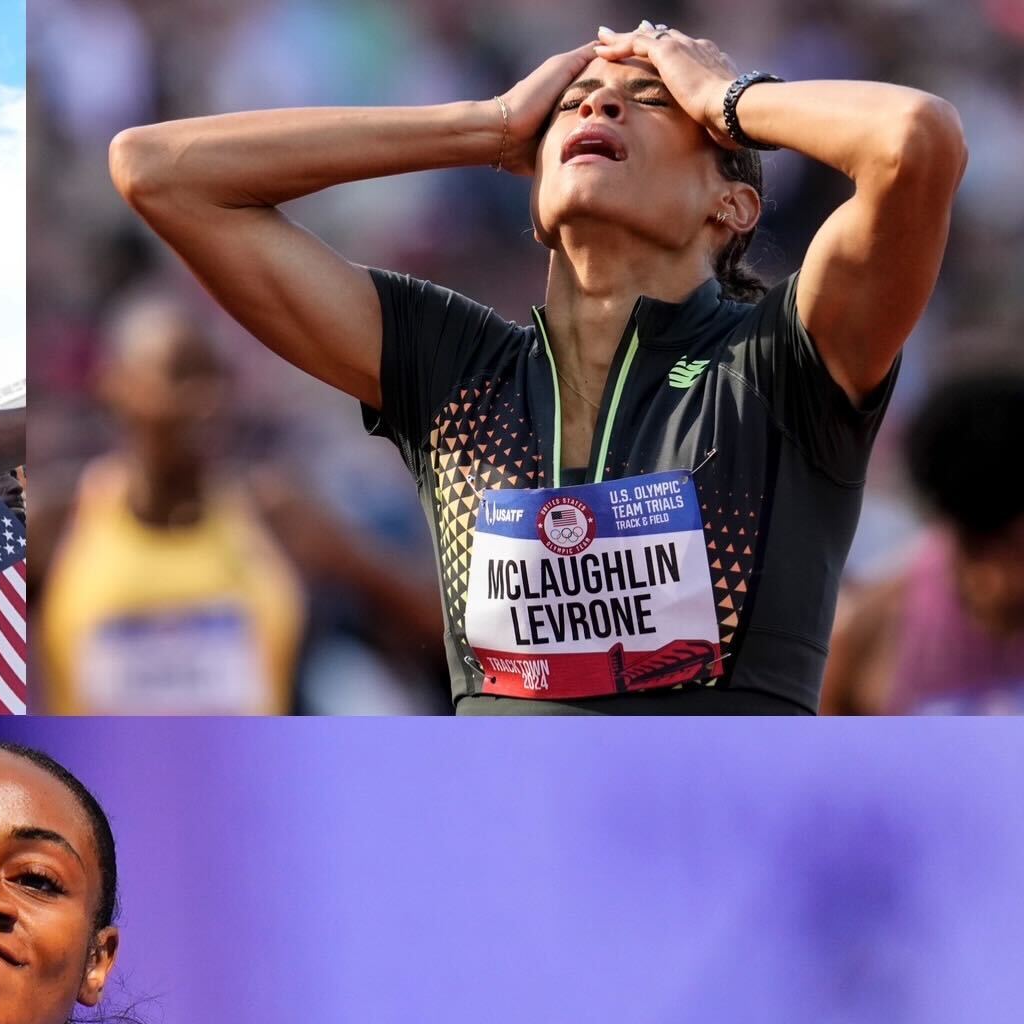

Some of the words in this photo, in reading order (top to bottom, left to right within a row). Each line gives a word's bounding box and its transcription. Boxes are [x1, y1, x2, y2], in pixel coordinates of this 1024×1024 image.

[609, 490, 633, 504] U.S.
[634, 480, 681, 500] OLYMPIC
[495, 508, 525, 523] USATF
[612, 502, 643, 519] TEAM
[645, 495, 685, 514] TRIALS
[616, 518, 642, 531] TRACK
[649, 512, 670, 526] FIELD
[487, 542, 681, 600] MCLAUGHLIN
[510, 593, 657, 646] LEVRONE
[486, 656, 550, 677] TRACKTOWN
[521, 672, 549, 690] 2024
